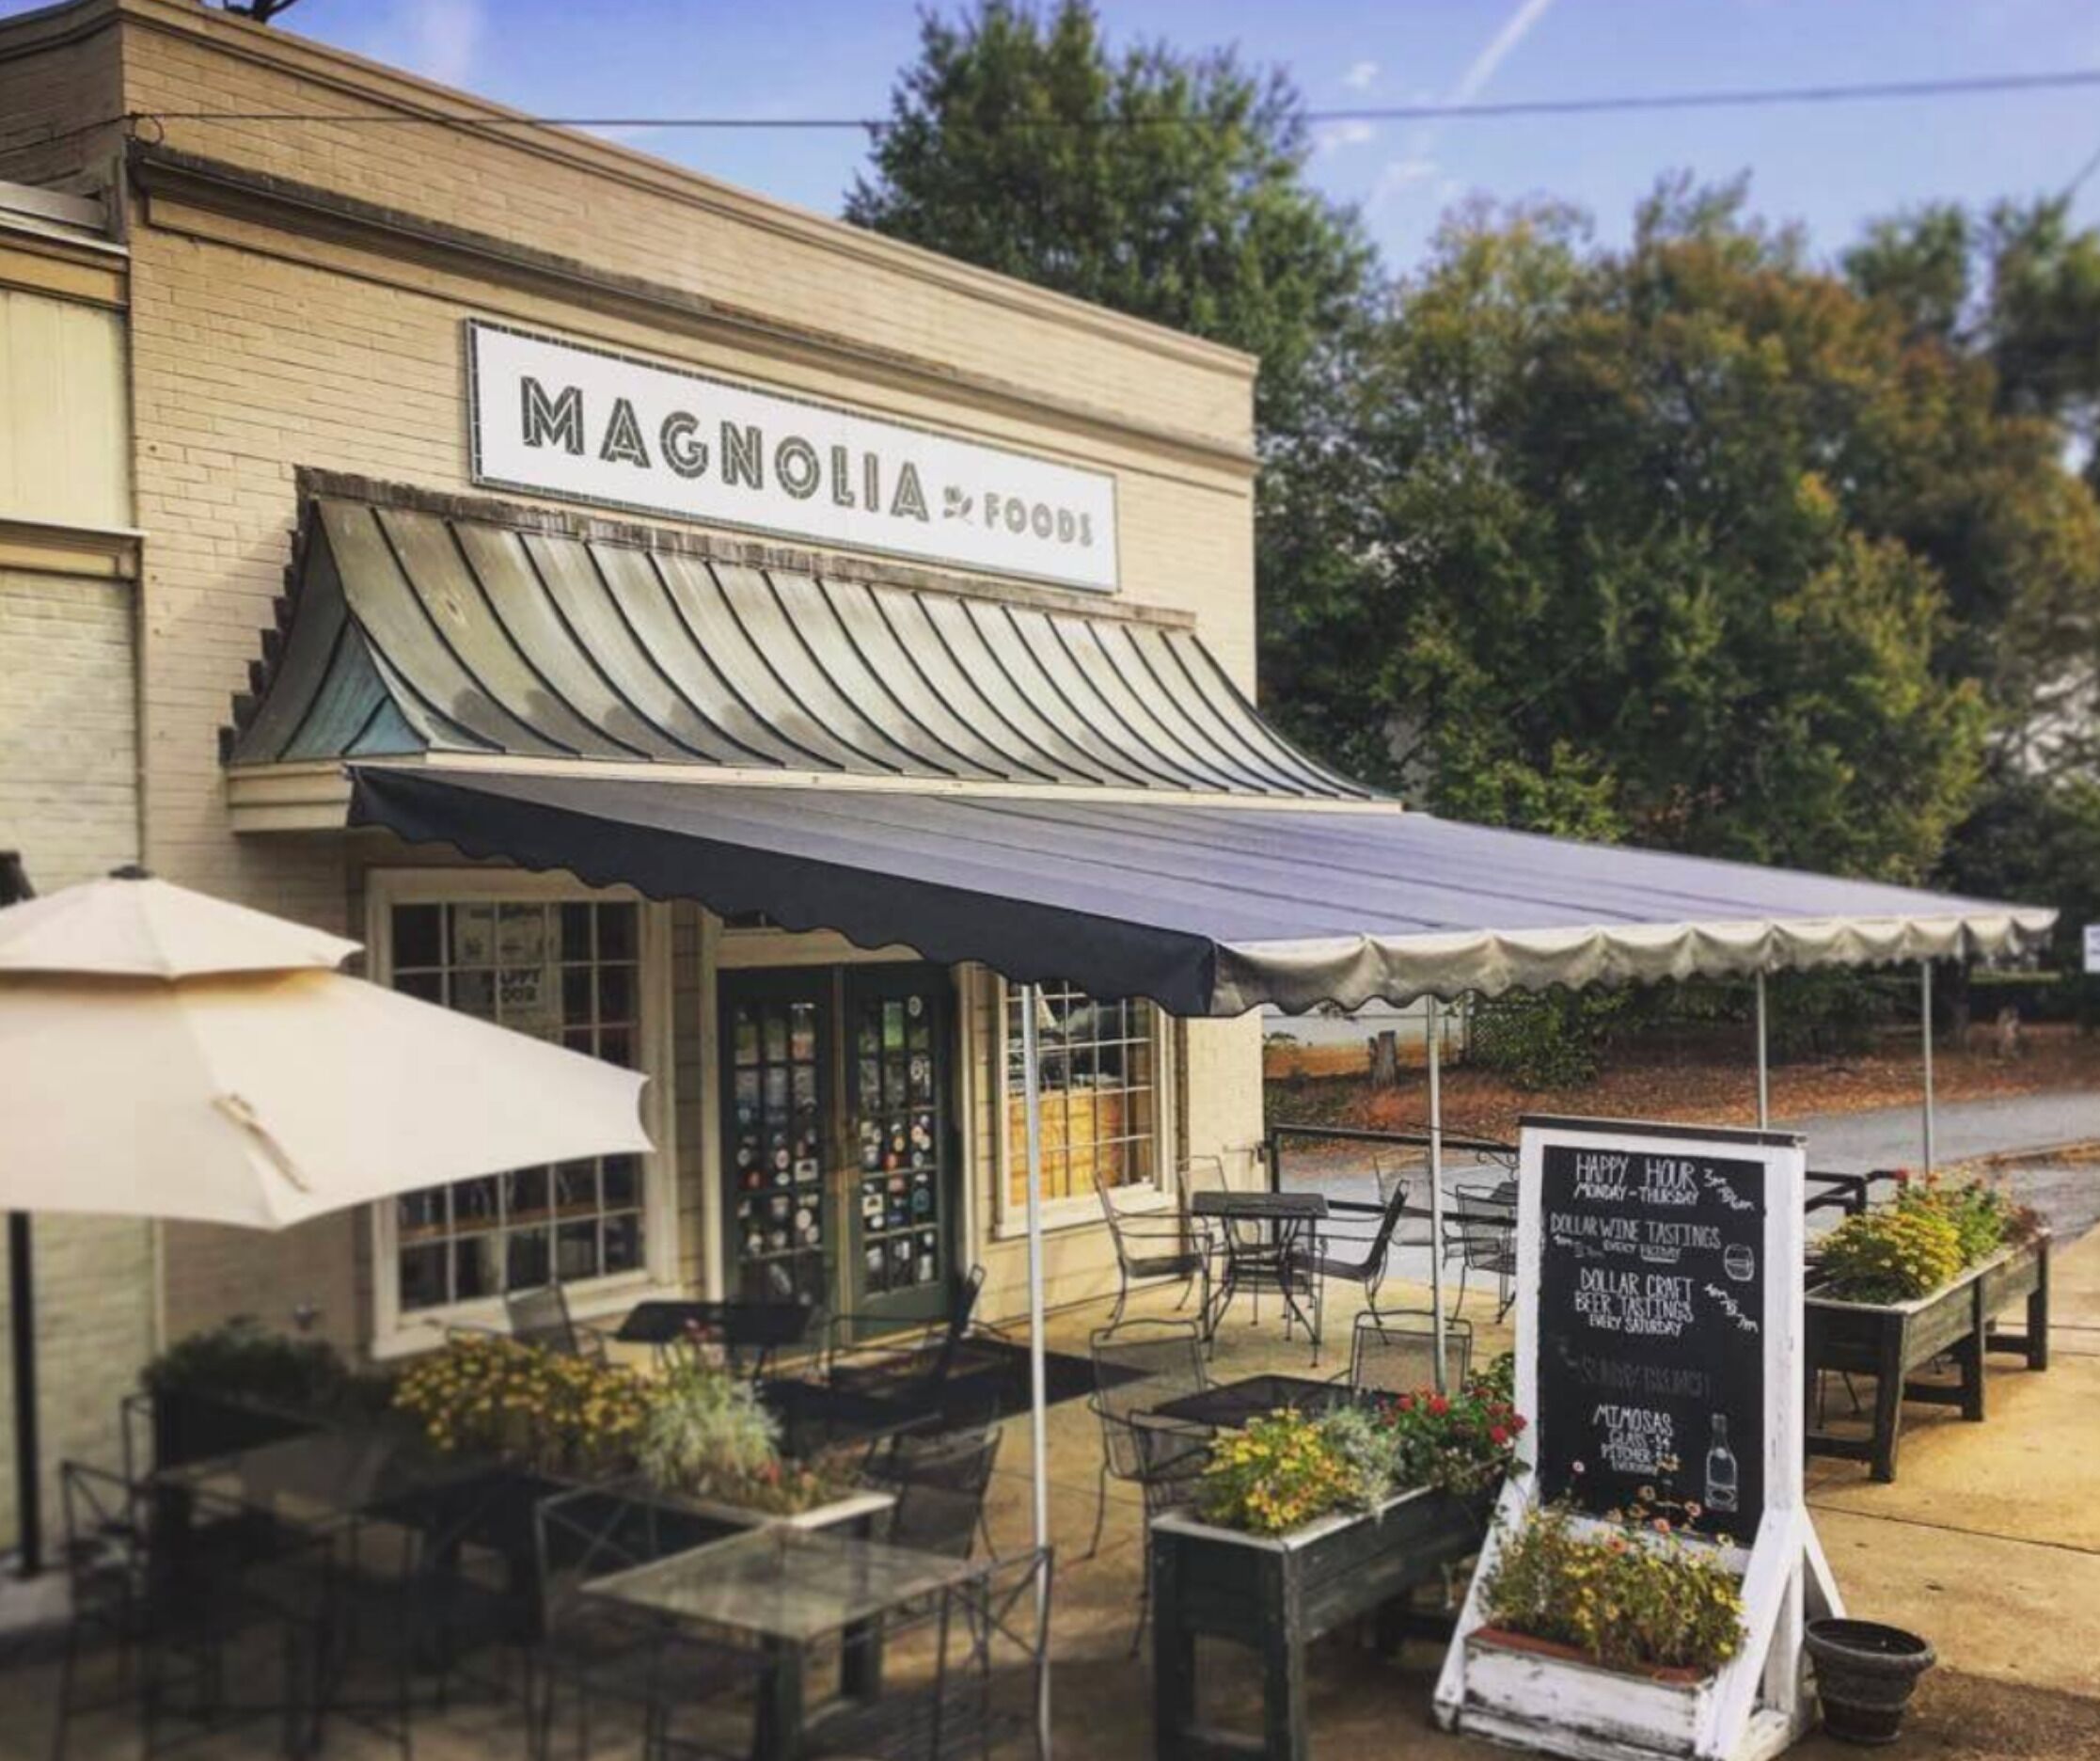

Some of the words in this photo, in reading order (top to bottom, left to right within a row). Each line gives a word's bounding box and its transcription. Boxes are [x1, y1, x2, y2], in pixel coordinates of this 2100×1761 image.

[520, 376, 929, 522] MAGNOLIA
[984, 493, 1094, 547] FOODS
[1576, 1153, 1629, 1185] HAPPY
[1646, 1158, 1699, 1193] HOUR
[1551, 1213, 1598, 1237] DOLLAR
[1601, 1220, 1640, 1242] WINE
[1648, 1222, 1721, 1249] TASTINGS
[1581, 1268, 1639, 1294] DOLLAR
[1647, 1274, 1694, 1300] CRAFT
[1574, 1291, 1611, 1316] BEER
[1620, 1295, 1694, 1323] TASTINGS
[1592, 1404, 1673, 1436] MIMOSAS
